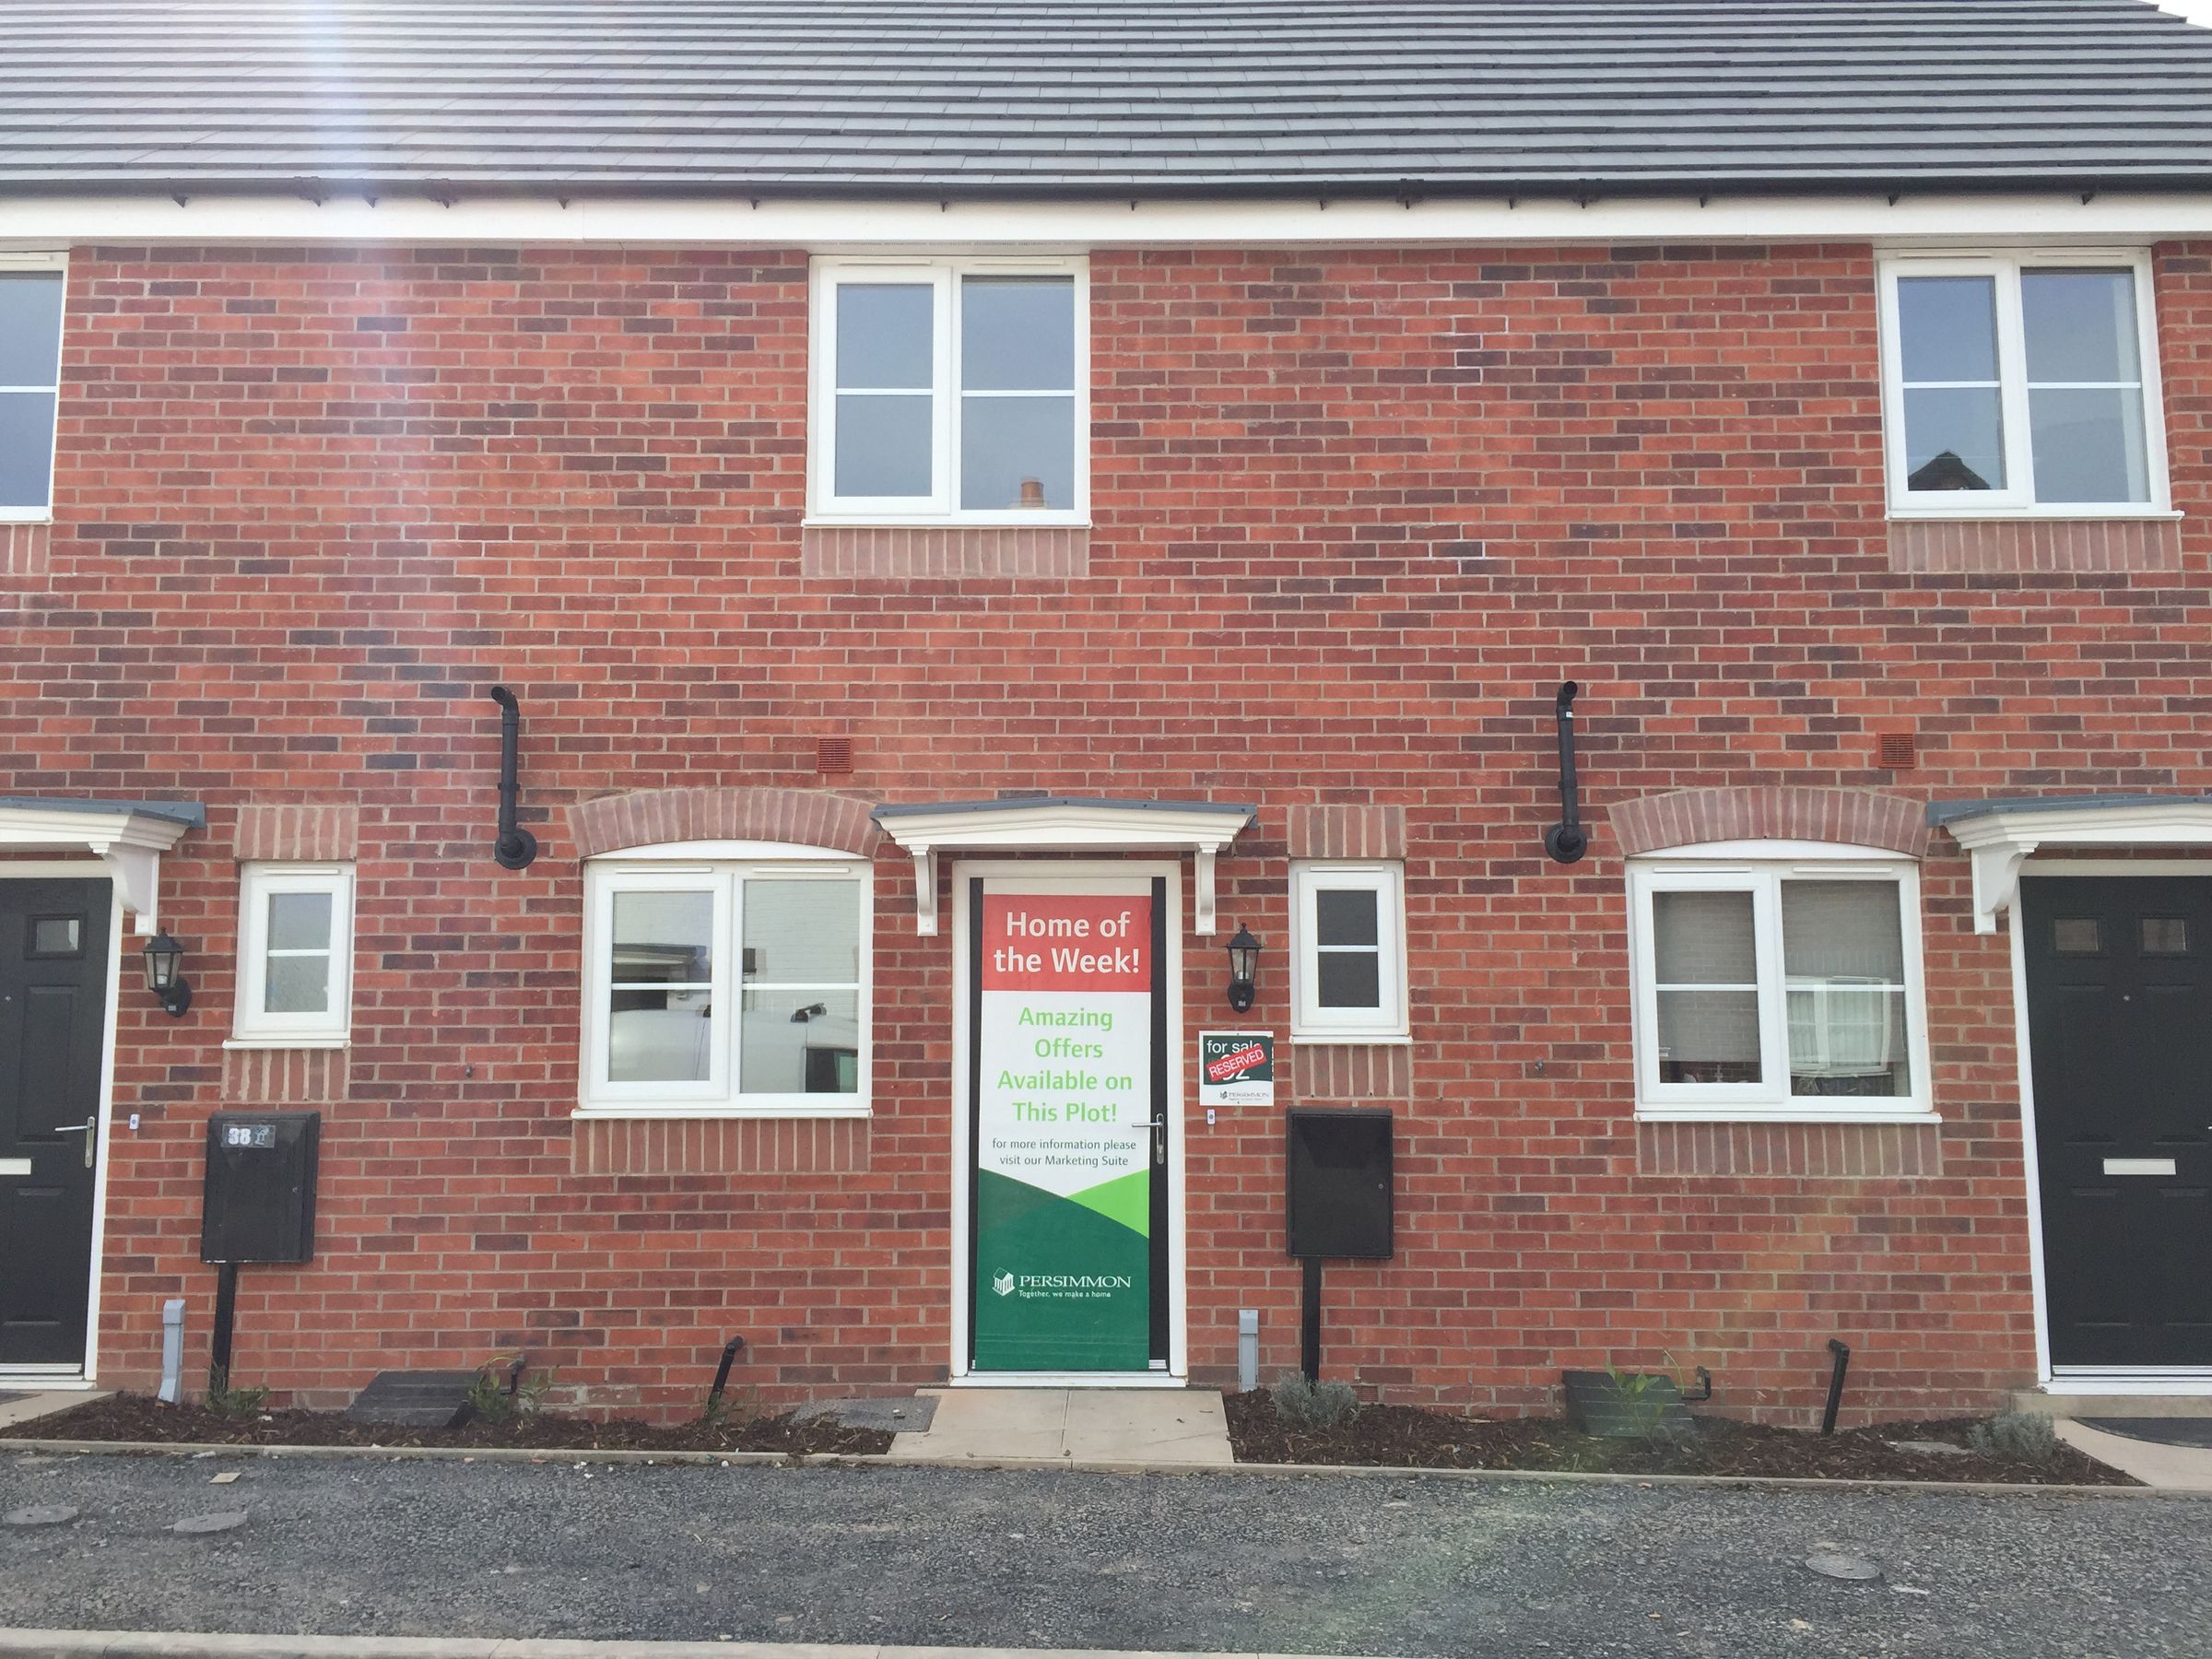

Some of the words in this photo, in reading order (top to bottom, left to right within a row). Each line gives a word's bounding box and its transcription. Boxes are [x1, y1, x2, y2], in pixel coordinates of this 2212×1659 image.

[1006, 912, 1090, 937] Home
[1100, 911, 1131, 937] of
[994, 946, 1041, 972] the
[1051, 947, 1139, 973] Week!
[1018, 1007, 1113, 1031] Amazing
[1034, 1038, 1103, 1058] Offers
[1206, 1040, 1228, 1053] for
[1208, 1049, 1264, 1077] RESERVED
[997, 1069, 1097, 1090] Available
[1105, 1076, 1133, 1090] on
[1012, 1102, 1057, 1122] This
[1065, 1102, 1116, 1123] Plot!
[993, 1137, 1006, 1148] for
[1010, 1140, 1036, 1149] more
[1040, 1139, 1100, 1150] information
[1103, 1140, 1136, 1152] please
[1000, 1156, 1020, 1165] visit
[1045, 1156, 1098, 1168] Marketing
[1102, 1157, 1128, 1166] Suite
[1019, 1276, 1131, 1288] PERSIMMON
[1018, 1290, 1050, 1299] Together,
